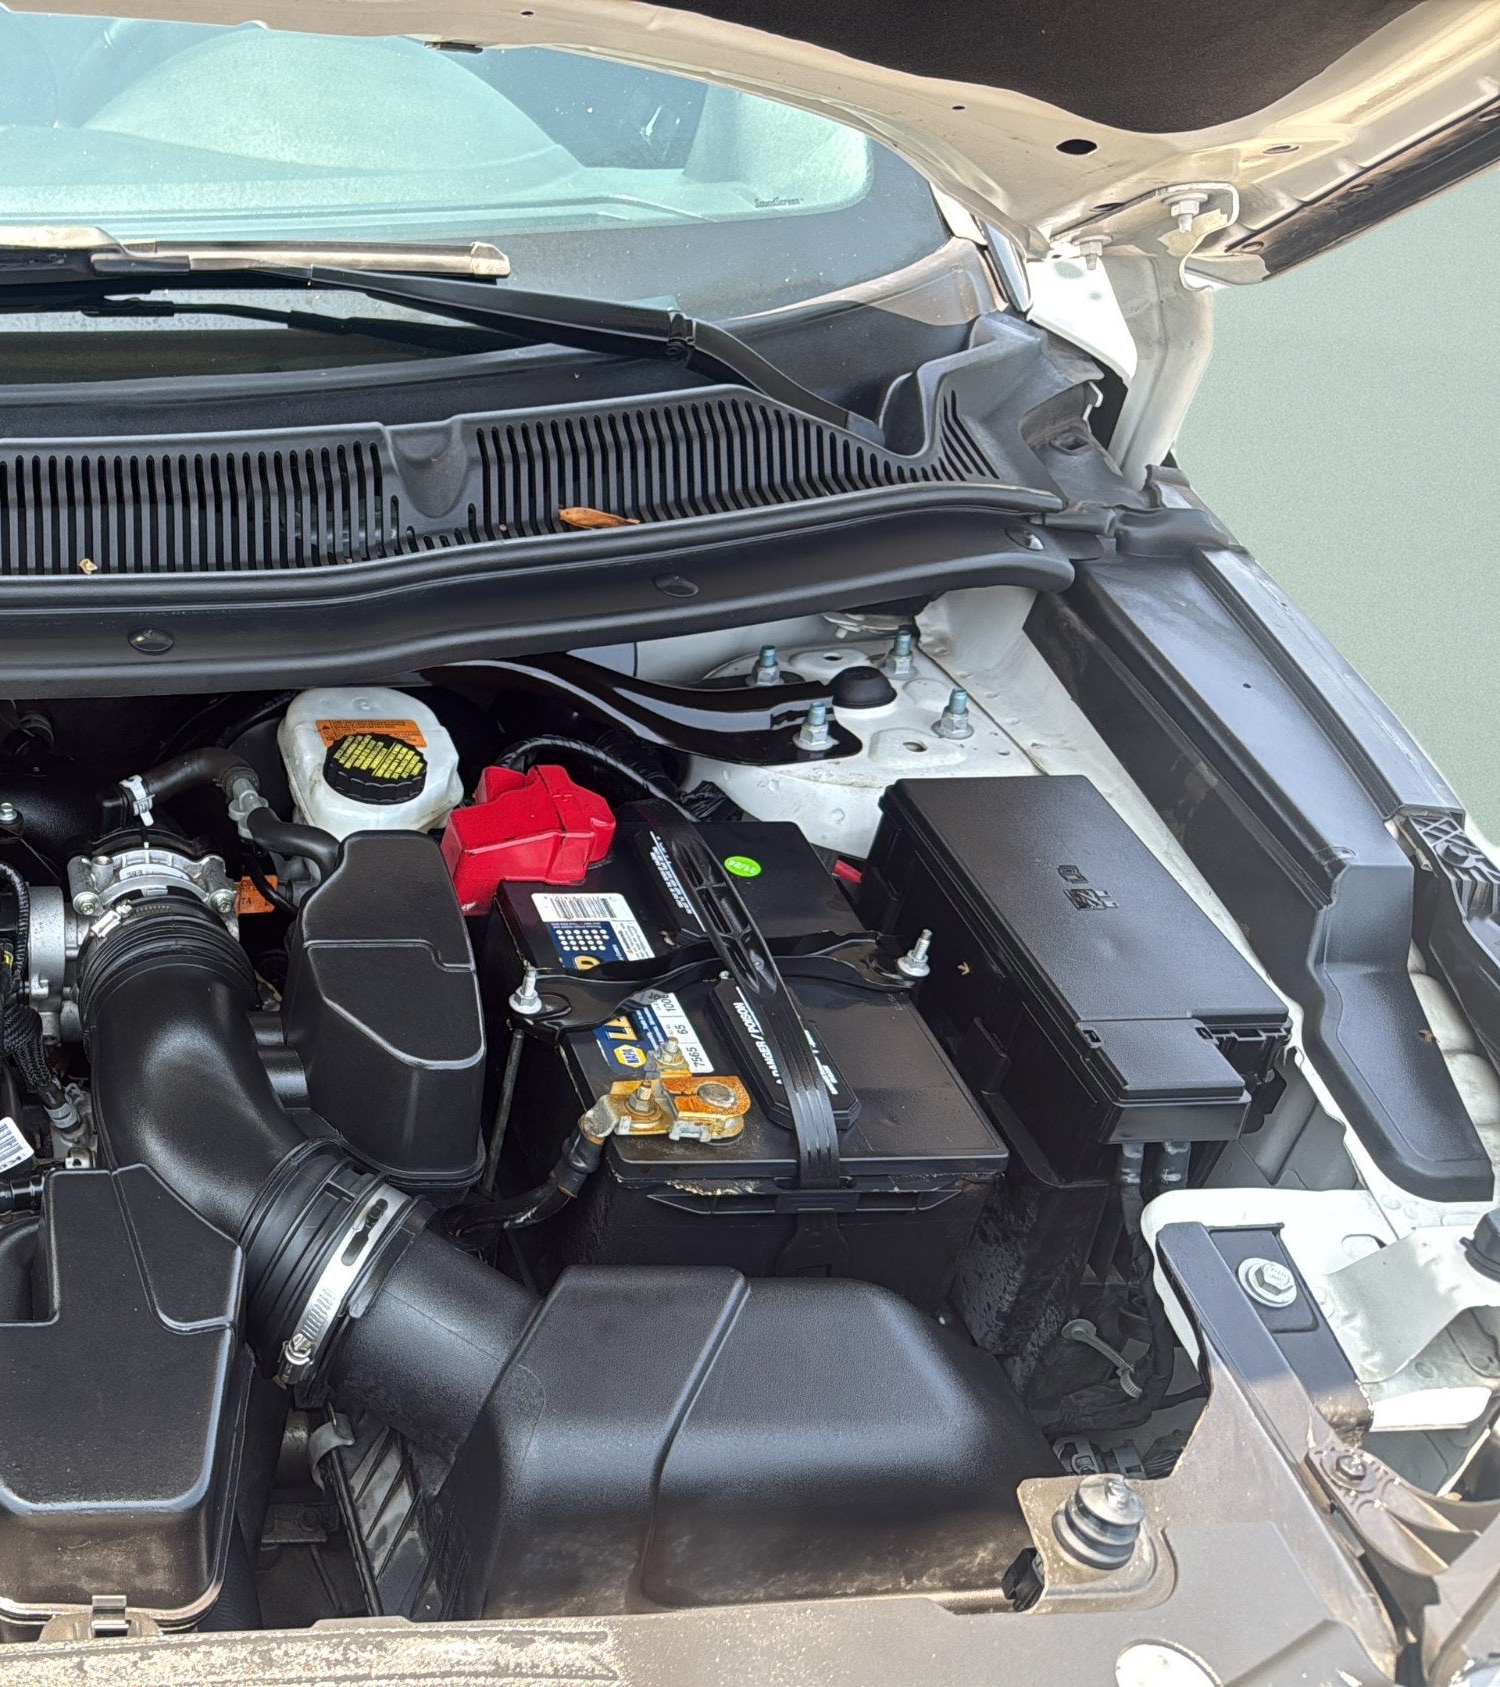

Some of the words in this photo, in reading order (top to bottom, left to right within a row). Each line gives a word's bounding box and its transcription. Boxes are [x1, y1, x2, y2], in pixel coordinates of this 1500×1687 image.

[732, 1002, 760, 1034] POISON
[675, 1024, 689, 1035] 65
[621, 1048, 640, 1064] NAPA
[686, 1046, 706, 1068] 7565
